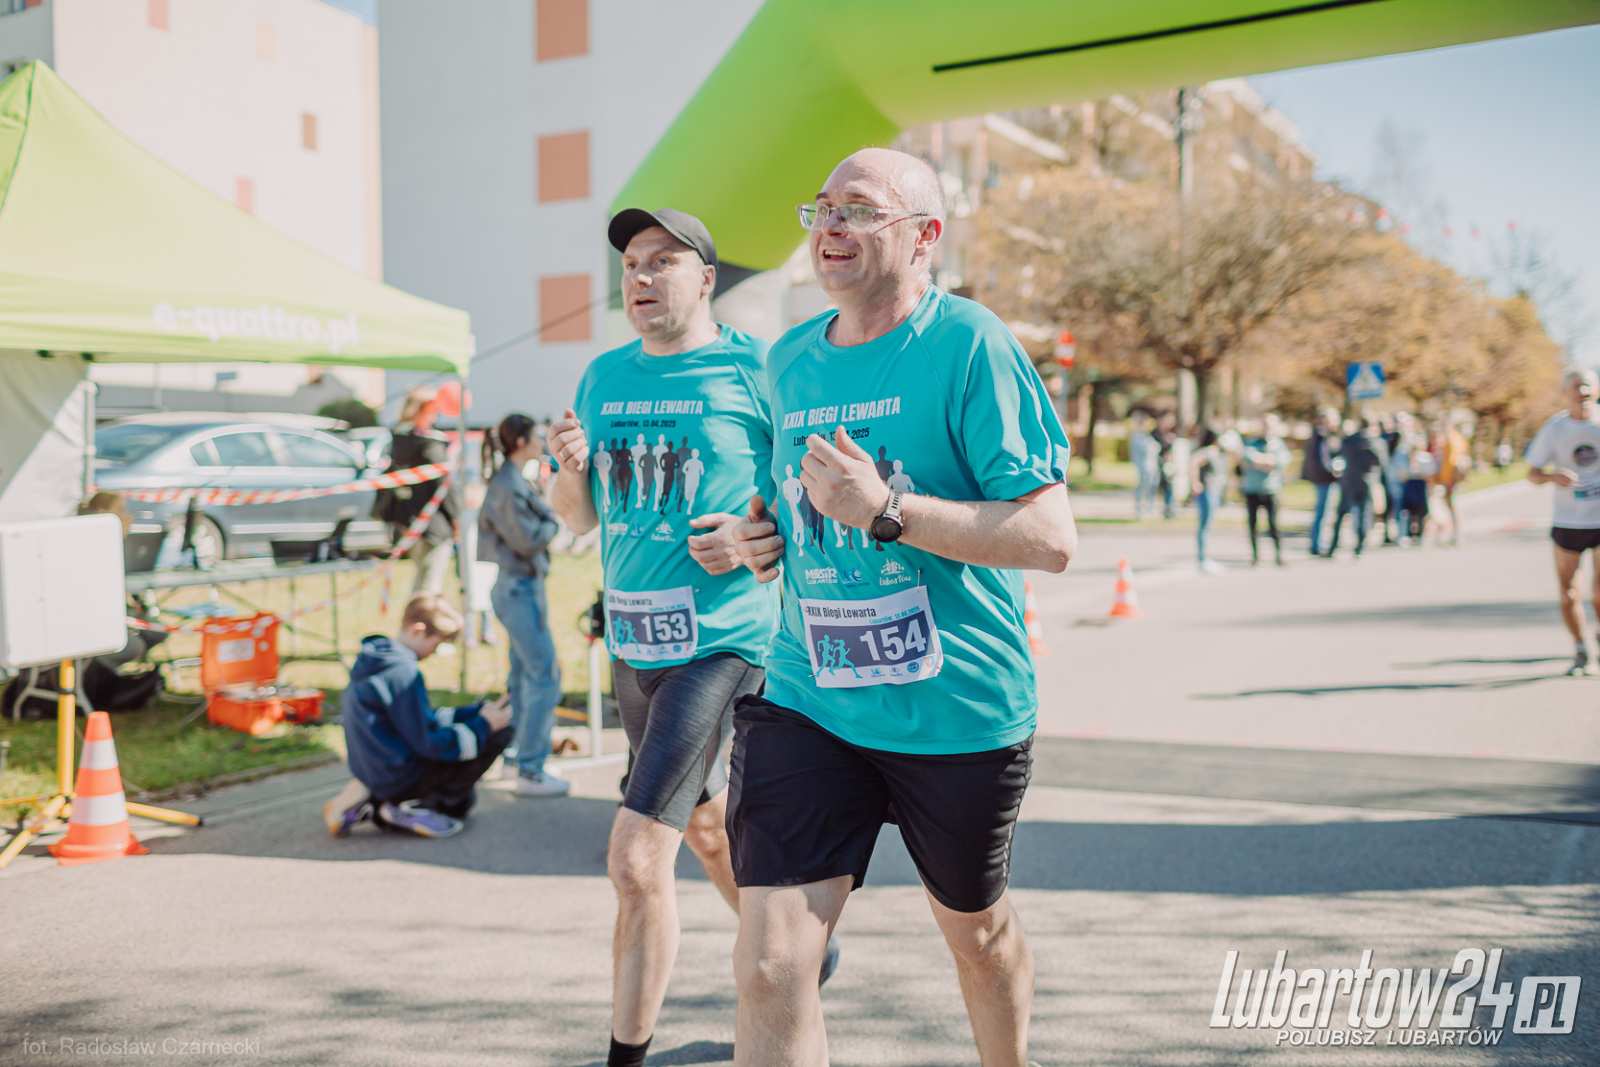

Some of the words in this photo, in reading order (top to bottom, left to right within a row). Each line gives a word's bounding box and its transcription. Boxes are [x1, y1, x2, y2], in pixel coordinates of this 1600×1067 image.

[600, 401, 624, 415] XXIX
[625, 400, 652, 415] BIEGI
[654, 400, 704, 415] LEWARTA
[782, 410, 806, 430] XXIX
[807, 405, 839, 426] BIEGI
[841, 396, 901, 422] LEWARTA
[641, 612, 689, 643] 153
[823, 607, 842, 619] Biegi
[842, 607, 877, 619] Lewarta
[859, 619, 927, 662] 154
